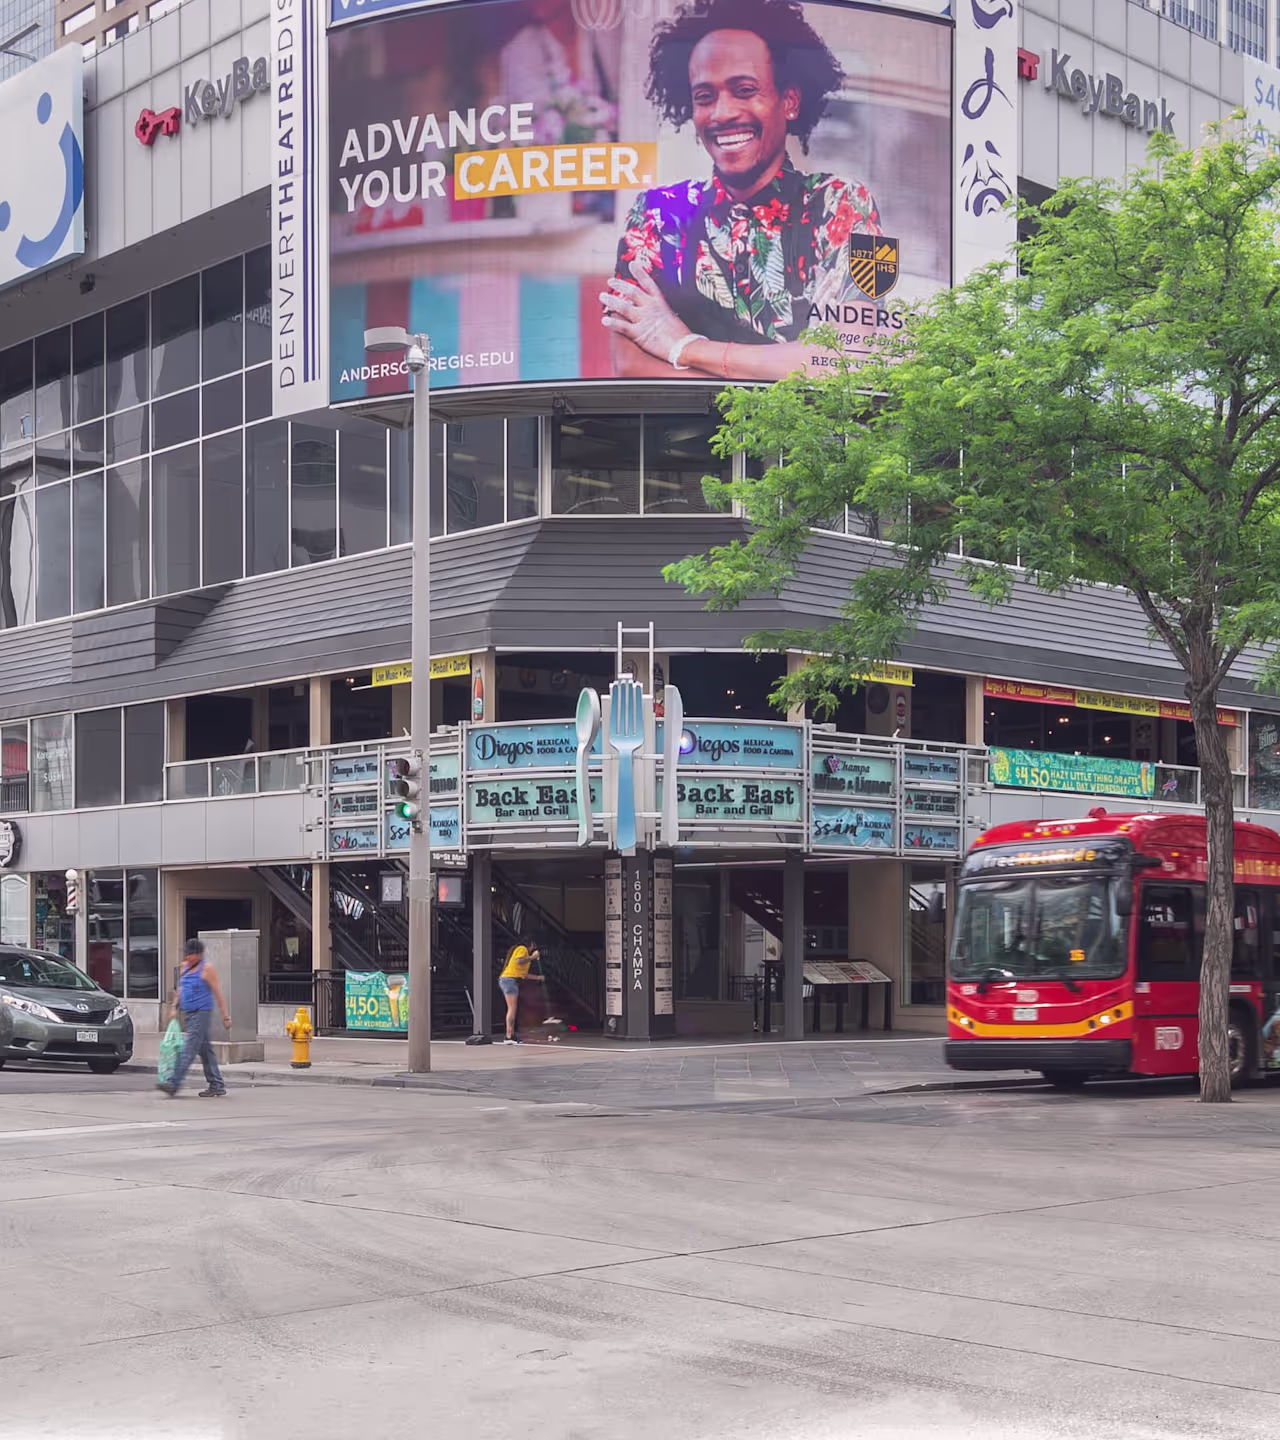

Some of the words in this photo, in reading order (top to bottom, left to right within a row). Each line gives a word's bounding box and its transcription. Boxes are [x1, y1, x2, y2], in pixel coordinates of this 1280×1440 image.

[184, 56, 271, 124] KeyBa
[339, 102, 535, 167] ADVANCE
[339, 160, 446, 212] YOUR
[459, 146, 652, 194] CAREER.
[851, 249, 873, 259] 1877
[876, 263, 896, 273] IHS
[806, 302, 917, 329] ANDERS
[475, 734, 534, 764] Diegos
[537, 738, 570, 746] MEXICAN
[743, 739, 773, 747] MEXICAN
[1015, 766, 1050, 787] $4.50
[1051, 770, 1068, 780] HAZY
[1070, 771, 1092, 781] LITTLE
[1093, 773, 1113, 783] THING
[1114, 775, 1139, 785] DRAFTS
[1061, 782, 1075, 790] ALL
[1076, 782, 1088, 791] DAY
[475, 787, 529, 807] Back
[677, 783, 735, 803] Back
[742, 785, 794, 804] East
[495, 807, 514, 817] Bar
[518, 806, 539, 817] and
[543, 805, 569, 815] Grill
[696, 804, 719, 814] Bar
[723, 804, 746, 814] and
[750, 804, 773, 815] Grill
[864, 821, 892, 829] KOREAN
[633, 870, 642, 913] 1600
[632, 924, 643, 990] CHAMPA
[345, 996, 379, 1015] $4.50
